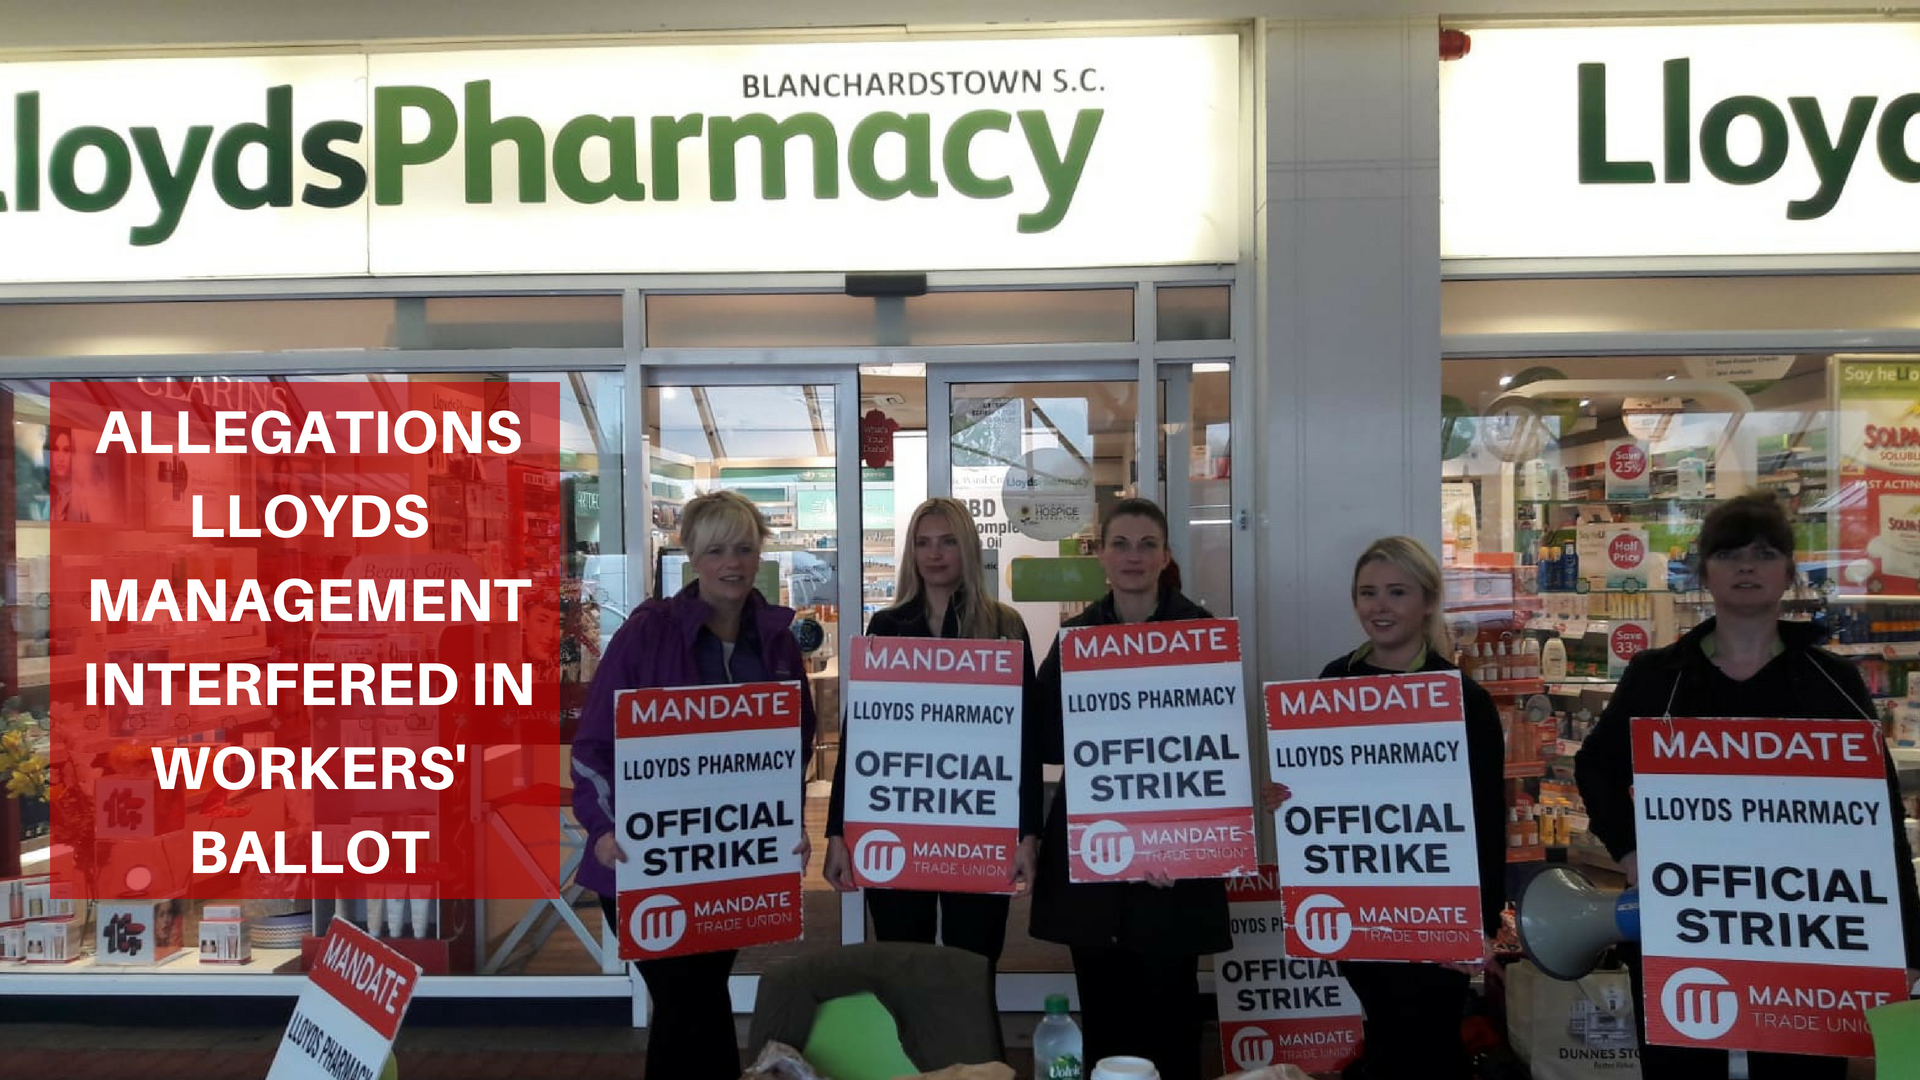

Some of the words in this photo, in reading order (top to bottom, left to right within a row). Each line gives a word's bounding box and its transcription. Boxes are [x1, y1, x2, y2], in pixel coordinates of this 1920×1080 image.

[741, 70, 1042, 99] BLANCHARDSTOWN
[1053, 67, 1105, 93] S.C.
[0, 79, 1104, 246] loydsPharmacy
[1845, 365, 1874, 384] Say
[1614, 461, 1641, 474] 25%
[1615, 451, 1639, 461] Save
[1612, 551, 1640, 563] Price
[1614, 540, 1638, 551] Half
[1074, 627, 1228, 659] MANDATE
[1616, 641, 1642, 652] 33%
[1617, 631, 1642, 641] Save
[864, 647, 1013, 673] MANDATE
[631, 691, 790, 725] MANDATE
[1068, 691, 1131, 713] LLOYDS
[1138, 686, 1236, 710] PHARMACY
[1280, 681, 1450, 716] MANDATE
[853, 701, 914, 721] LLOYDS
[921, 703, 1015, 725] PHARMACY
[1073, 734, 1240, 767] OFFICIAL
[1276, 745, 1344, 768] LLOYDS
[1351, 740, 1460, 765] PHARMACY
[1652, 731, 1867, 762] MANDATE
[624, 757, 690, 780] LLOYDS
[698, 750, 796, 775] PHARMACY
[855, 750, 1013, 781] OFFICIAL
[1090, 769, 1226, 802] STRIKE
[868, 785, 996, 816] STRIKE
[1644, 797, 1732, 822] LLOYDS
[1742, 799, 1880, 825] PHARMACY
[625, 800, 794, 841] OFFICIAL
[1284, 803, 1465, 835] OFFICIAL
[1141, 826, 1242, 845] MANDATE
[643, 836, 779, 876] STRIKE
[913, 841, 1006, 860] MANDATE
[1145, 848, 1191, 862] TRADE
[1196, 848, 1244, 861] UNION
[1304, 843, 1450, 874] STRIKE
[913, 861, 957, 875] TRADE
[963, 862, 1007, 877] UNION
[1652, 862, 1888, 905] OFFICIAL
[694, 891, 791, 918] MANDATE
[1359, 906, 1468, 924] MANDATE
[695, 917, 742, 934] TRADE
[747, 911, 793, 928] UNION
[1363, 929, 1412, 943] TRADE
[1418, 930, 1470, 943] UNION
[1676, 907, 1869, 951] STRIKE
[322, 933, 407, 1014] MANDATE
[1237, 985, 1342, 1012] STRIKE
[287, 1011, 325, 1059] LLOYDS
[1752, 1013, 1819, 1031] TRADE
[1279, 1030, 1355, 1046] MANDATE
[1282, 1048, 1318, 1060] TRADE
[1321, 1047, 1357, 1058] UNION
[1559, 1048, 1616, 1060] DUNNES
